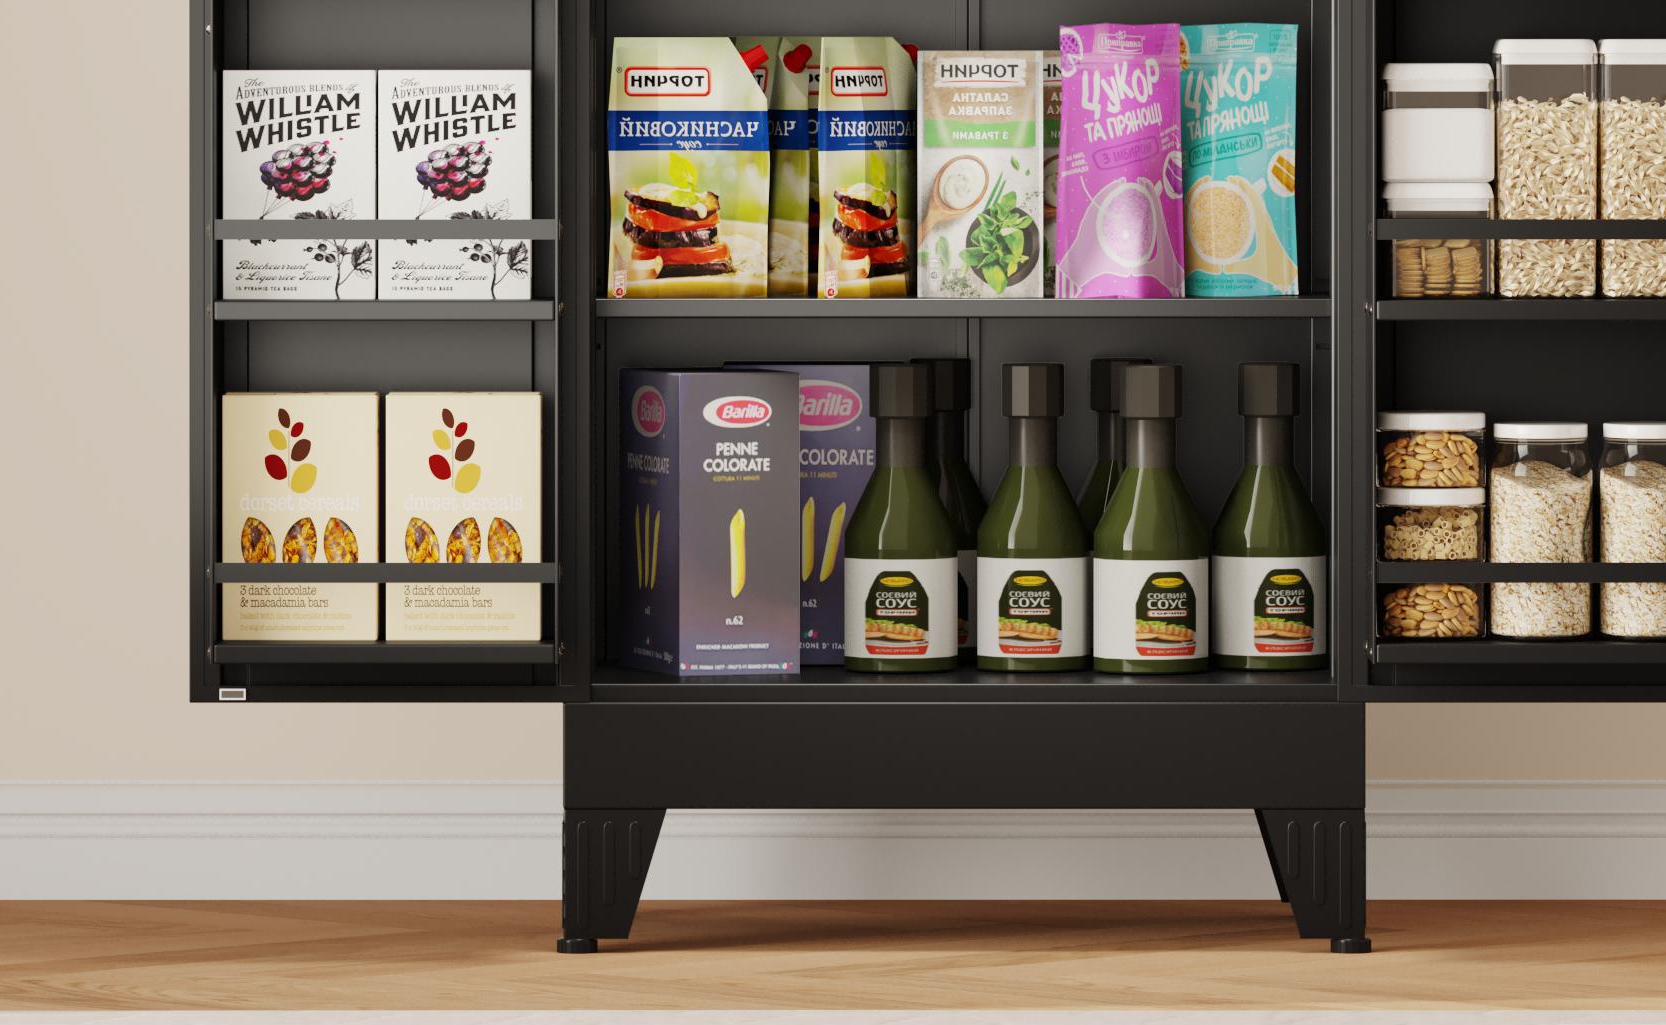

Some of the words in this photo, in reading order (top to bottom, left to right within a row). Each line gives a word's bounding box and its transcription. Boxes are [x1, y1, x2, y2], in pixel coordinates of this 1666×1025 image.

[236, 84, 306, 99] ADVENTUROUS
[309, 84, 344, 93] BLENDS
[392, 84, 462, 99] ADVENTUROUS
[465, 84, 500, 93] BLENDS
[1081, 58, 1159, 119] ЦУКОР
[1185, 56, 1273, 118] ЦУКОР
[235, 93, 360, 126] WILLIAM
[391, 93, 516, 126] WILLIAM
[235, 113, 360, 152] WHISTLE
[391, 113, 516, 152] WHISTLE
[1084, 120, 1107, 143] ТА
[236, 260, 308, 270] Blackcurrant
[392, 260, 464, 270] Blackcurrant
[722, 403, 765, 419] Barilla
[715, 441, 759, 457] PENNE
[703, 458, 771, 473] COLORATE
[240, 585, 247, 596] 3
[248, 585, 271, 596] dark
[272, 585, 317, 596] chocolate
[404, 585, 411, 596] 3
[412, 585, 435, 596] dark
[436, 585, 481, 596] chocolate
[240, 597, 249, 608] &
[250, 597, 306, 608] macadamia
[308, 597, 329, 608] bars
[404, 597, 413, 608] &
[414, 597, 470, 608] macadamia
[472, 597, 493, 608] bars
[875, 598, 917, 608] СОУС
[1008, 598, 1051, 608] СОУС
[1146, 600, 1187, 610] СОУС
[1265, 596, 1305, 606] СОУС
[725, 615, 744, 626] n.62
